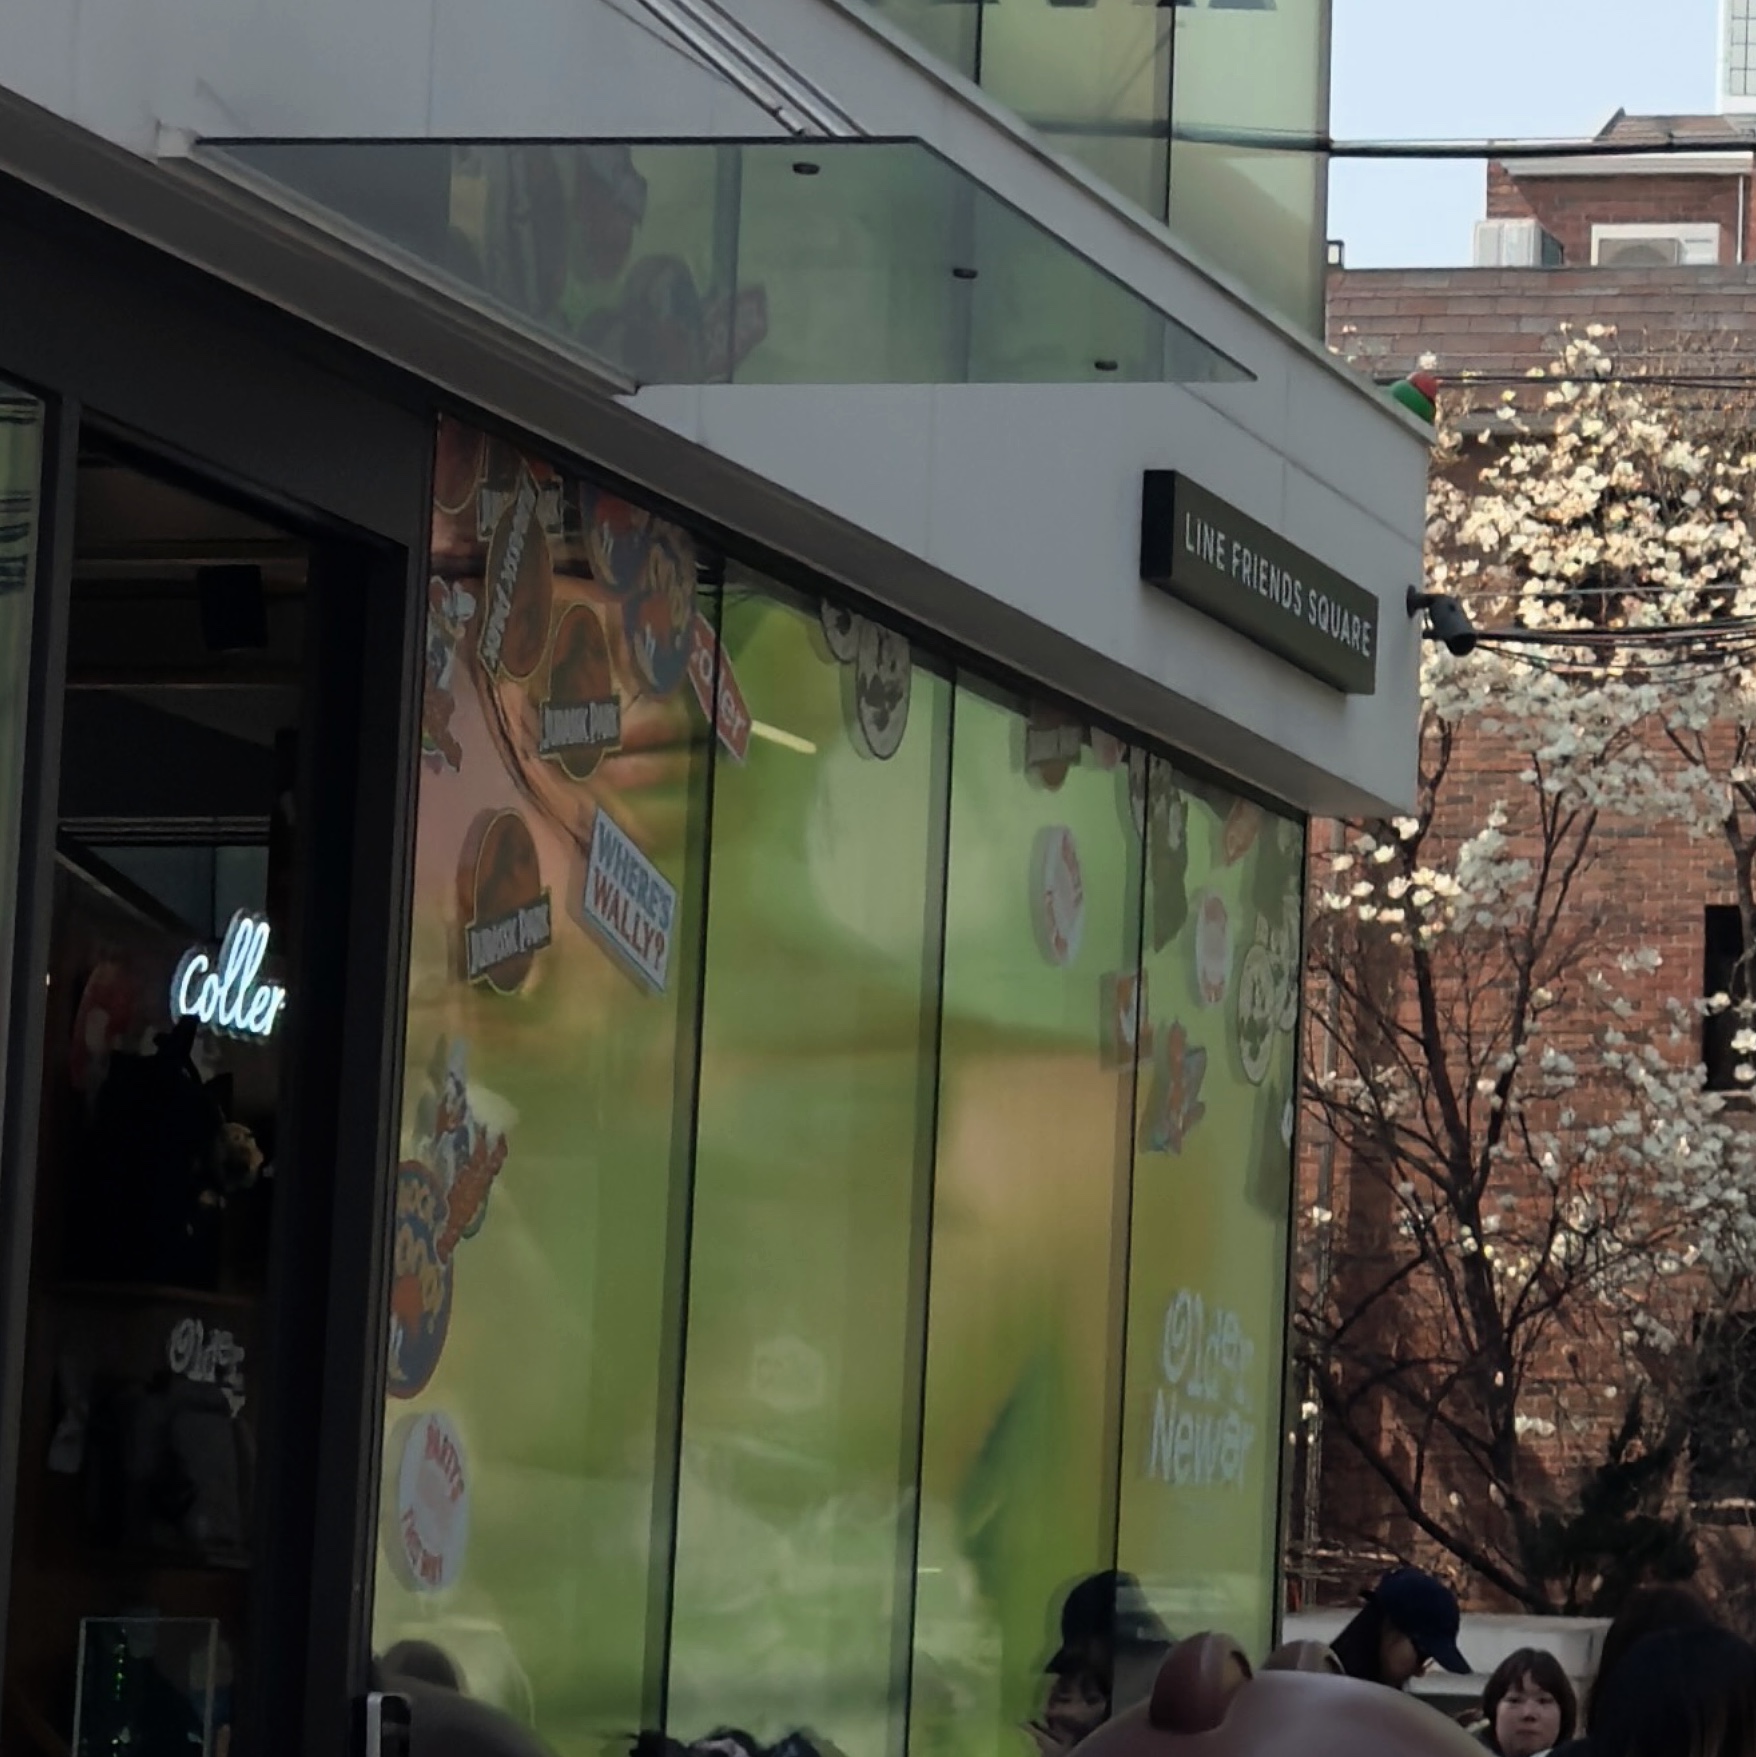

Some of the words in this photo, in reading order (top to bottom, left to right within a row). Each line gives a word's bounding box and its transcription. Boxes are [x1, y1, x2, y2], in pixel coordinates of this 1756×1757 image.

[1184, 511, 1226, 572] LINE
[1230, 539, 1303, 618] FRIENDS
[1307, 587, 1373, 658] SQUARE
[593, 868, 666, 971] WALLY?
[597, 820, 673, 931] WHERE'S
[178, 917, 286, 1037] Coller
